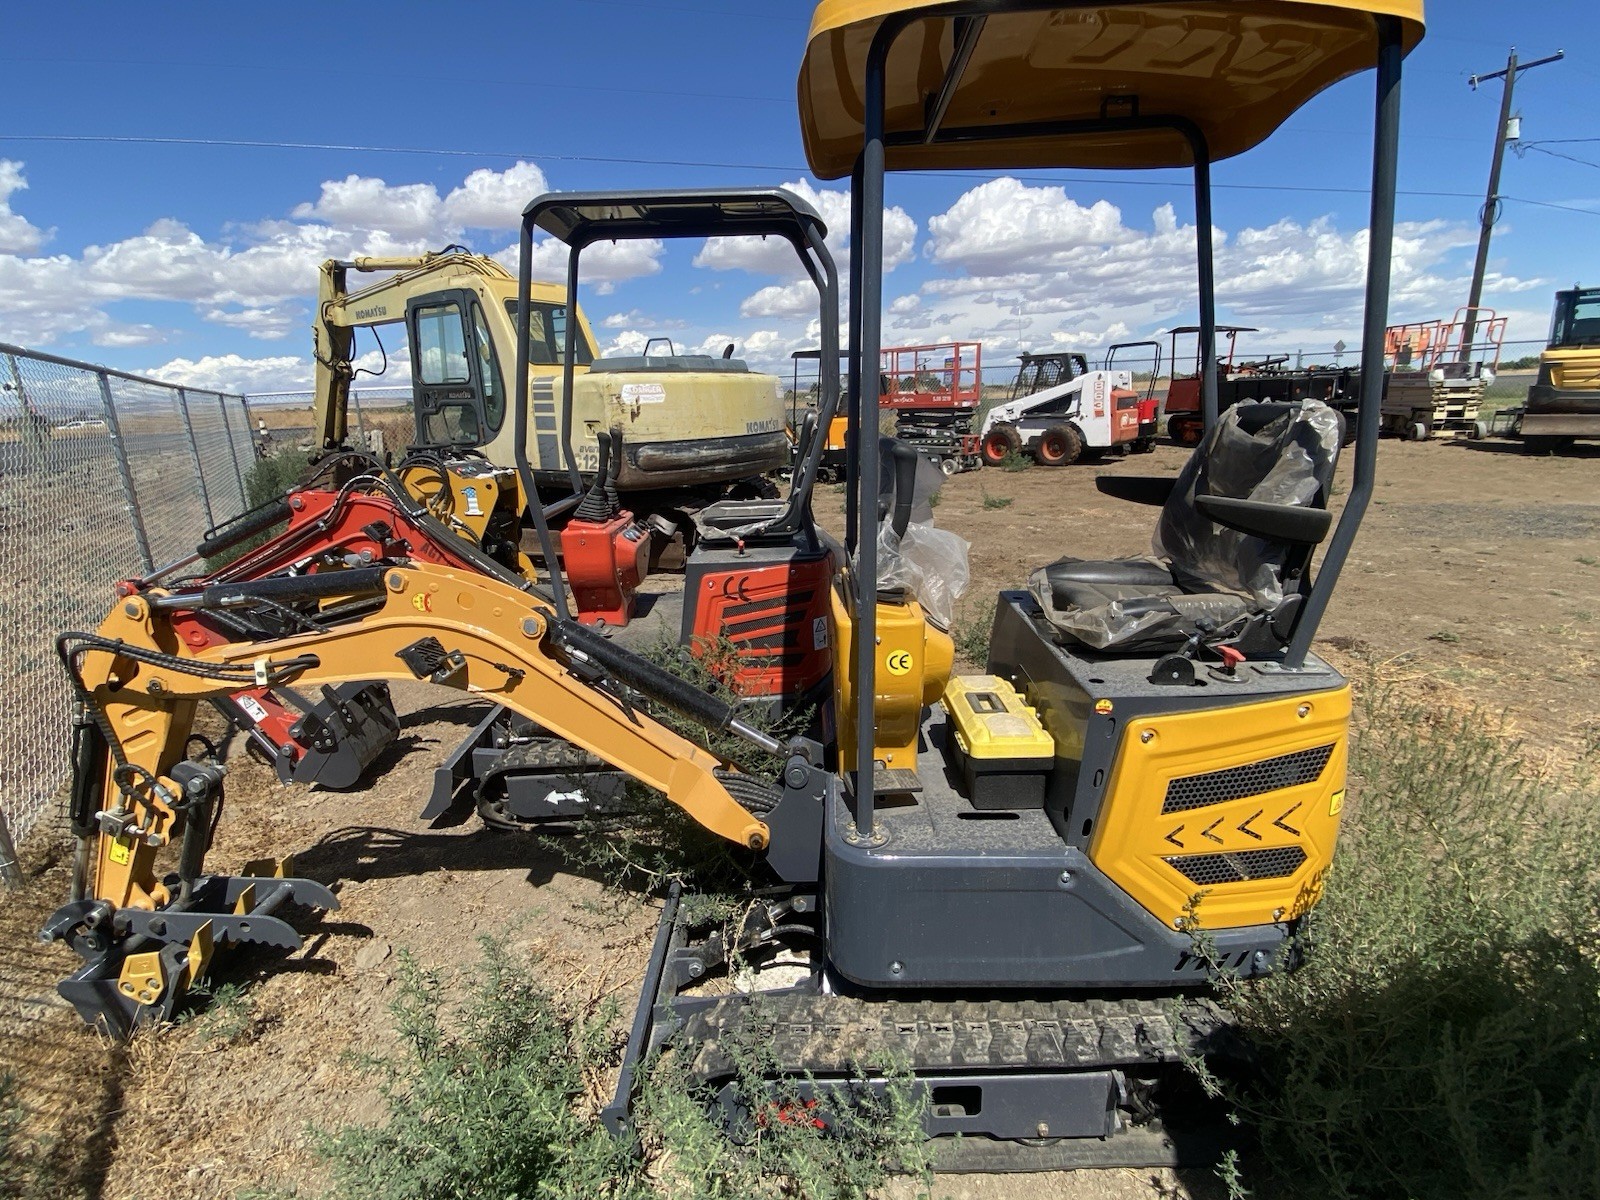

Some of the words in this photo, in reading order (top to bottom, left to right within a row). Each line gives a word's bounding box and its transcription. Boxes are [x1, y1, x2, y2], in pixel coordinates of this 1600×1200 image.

[355, 305, 387, 319] KOMATSU
[746, 417, 779, 433] KOMATSU
[723, 575, 752, 602] CE
[889, 654, 909, 670] CE
